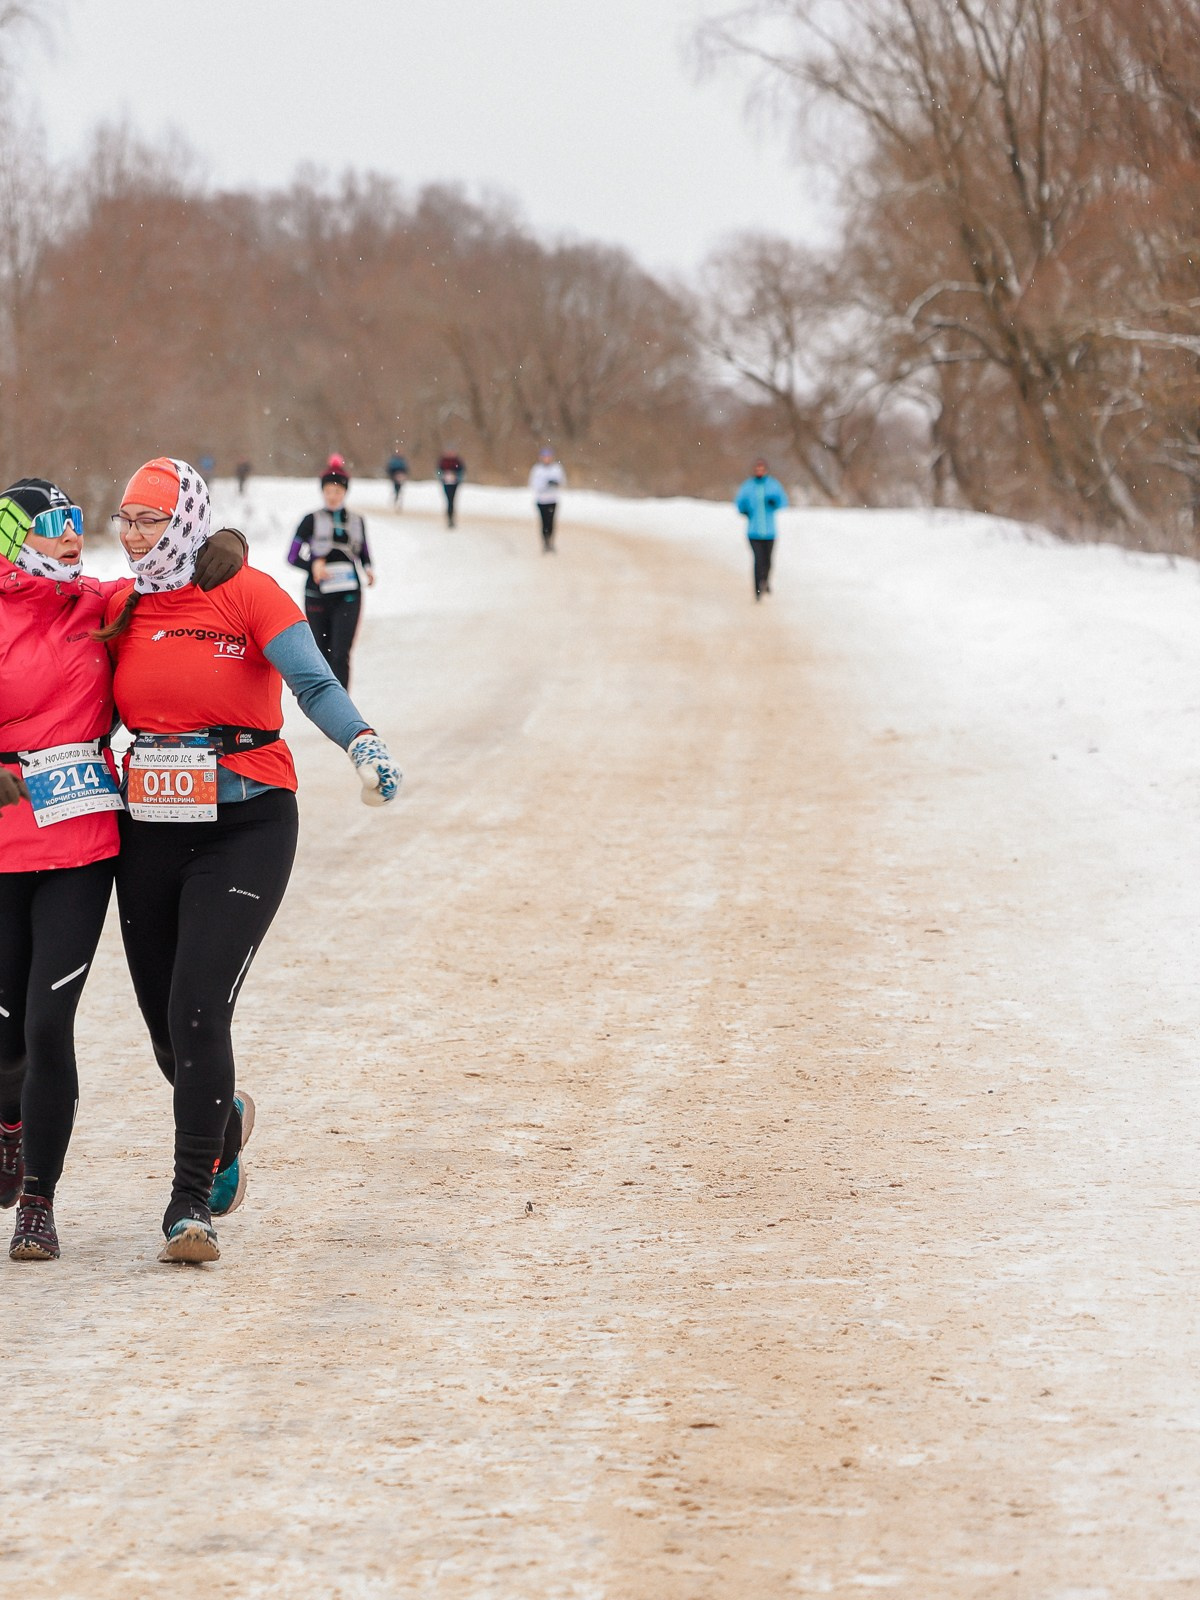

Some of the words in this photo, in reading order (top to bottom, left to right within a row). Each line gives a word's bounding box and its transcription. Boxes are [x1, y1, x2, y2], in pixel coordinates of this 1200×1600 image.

[152, 629, 247, 646] #novgorod
[214, 641, 246, 656] TRI
[45, 749, 81, 764] NOVGOROD
[143, 754, 179, 763] NOVGOROD
[180, 754, 192, 764] ICE
[49, 764, 99, 796] 214
[143, 771, 195, 796] 010
[45, 793, 76, 806] КОРЧИГО
[77, 787, 110, 797] ЕКАТЕРИНА
